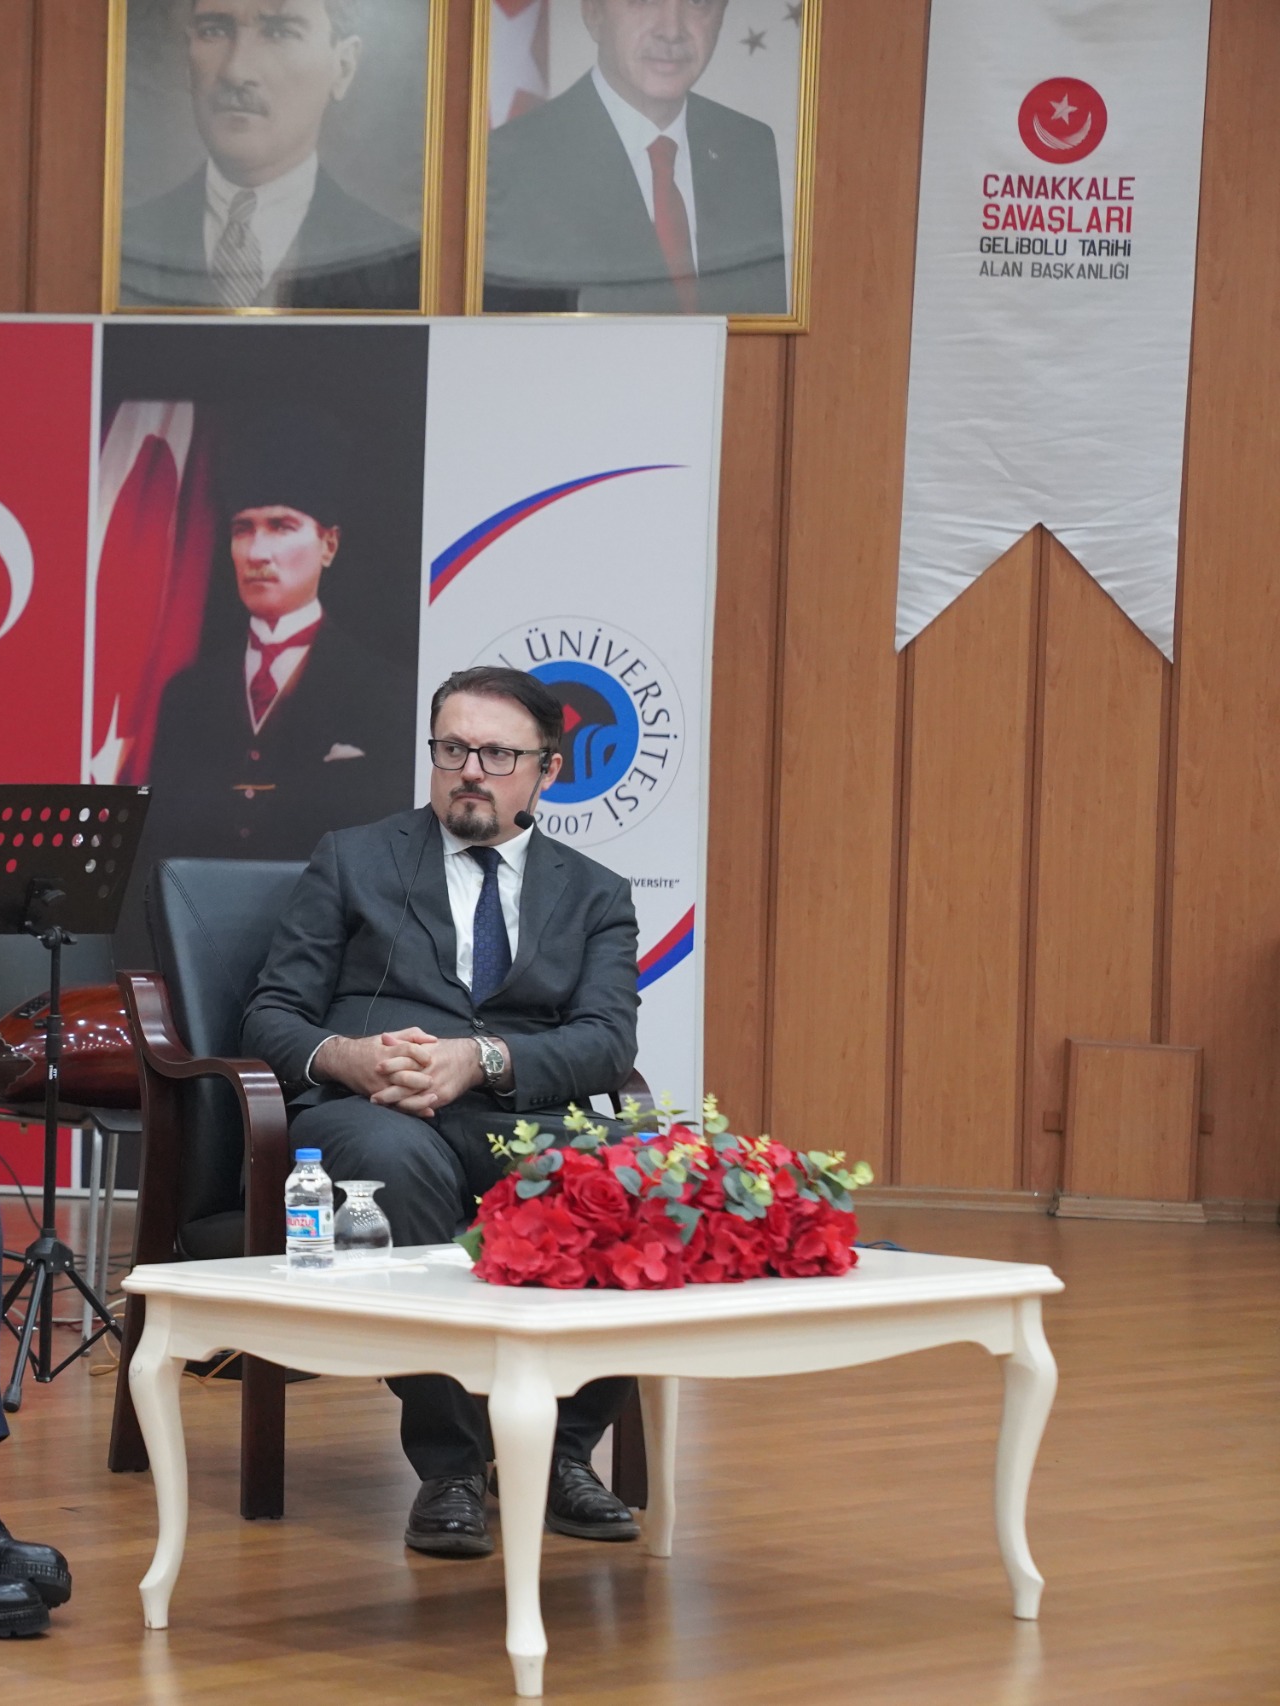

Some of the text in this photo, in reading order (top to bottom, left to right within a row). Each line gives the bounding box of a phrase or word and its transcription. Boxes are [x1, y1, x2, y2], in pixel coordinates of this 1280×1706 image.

[982, 174, 1136, 201] ÇANAKKALE
[982, 203, 1133, 234] SAVAŞLARI
[979, 260, 1130, 280] ALAN BAŞKANLIĞI
[524, 627, 678, 828] ÜNİVERSİTESİ
